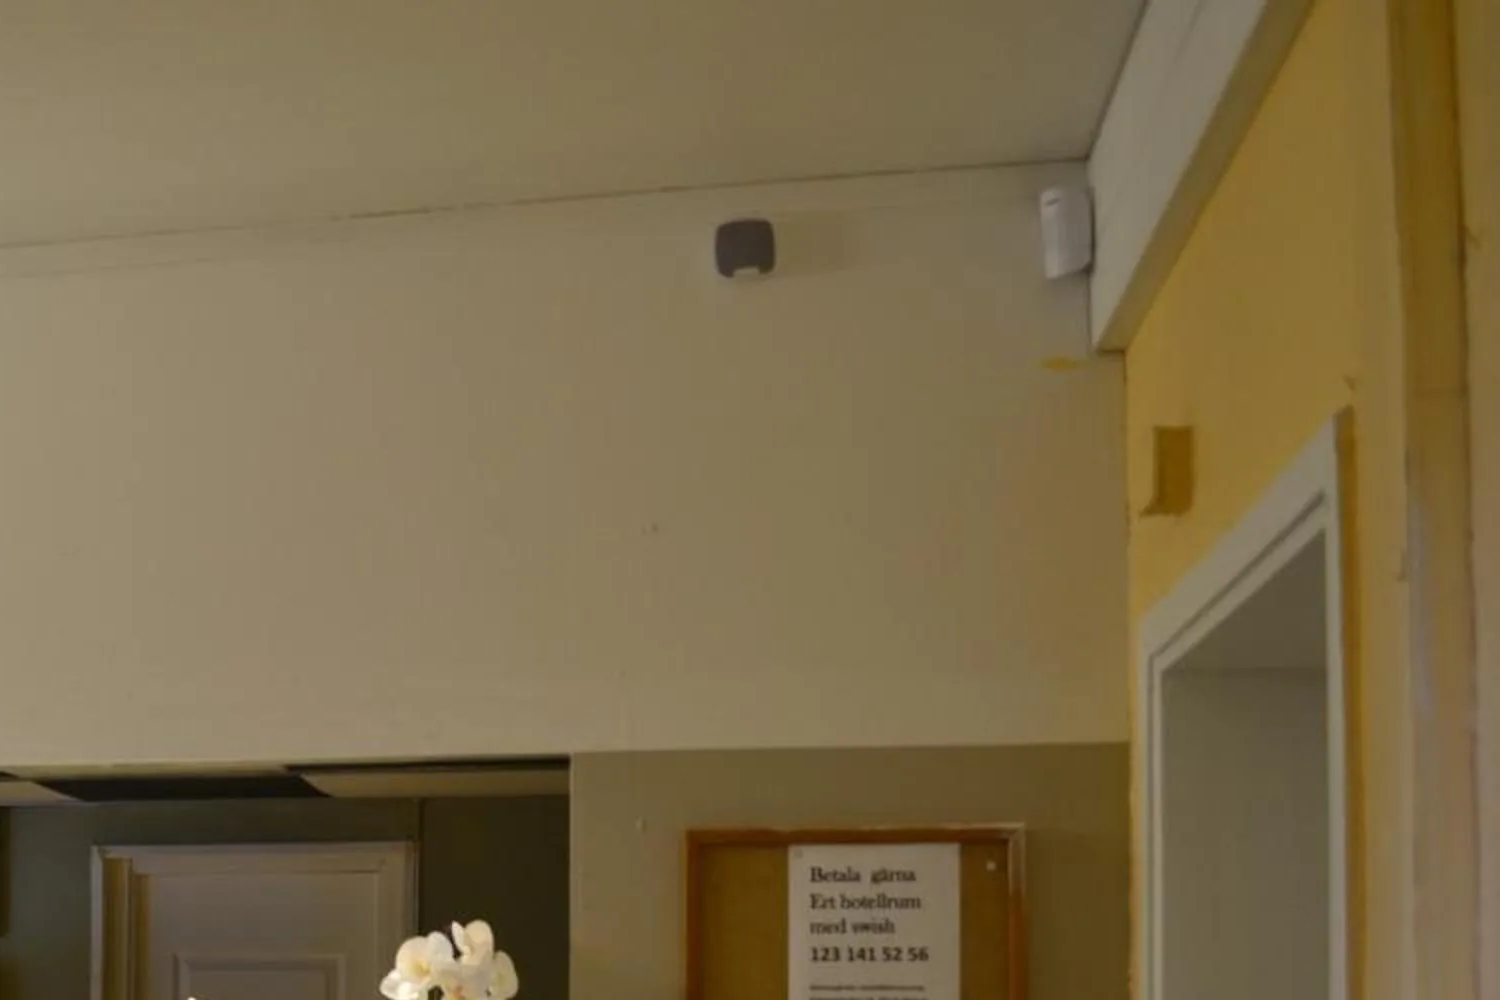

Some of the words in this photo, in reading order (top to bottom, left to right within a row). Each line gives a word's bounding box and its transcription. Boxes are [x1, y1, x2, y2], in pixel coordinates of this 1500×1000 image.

[810, 866, 861, 883] Betala
[870, 866, 917, 886] gärna
[809, 893, 836, 909] Ert
[840, 893, 922, 910] hotellrum
[809, 918, 847, 934] med
[851, 917, 896, 934] swish
[811, 946, 841, 962] 123
[847, 946, 876, 962] 141
[881, 946, 903, 962] 52
[907, 945, 930, 962] 56
